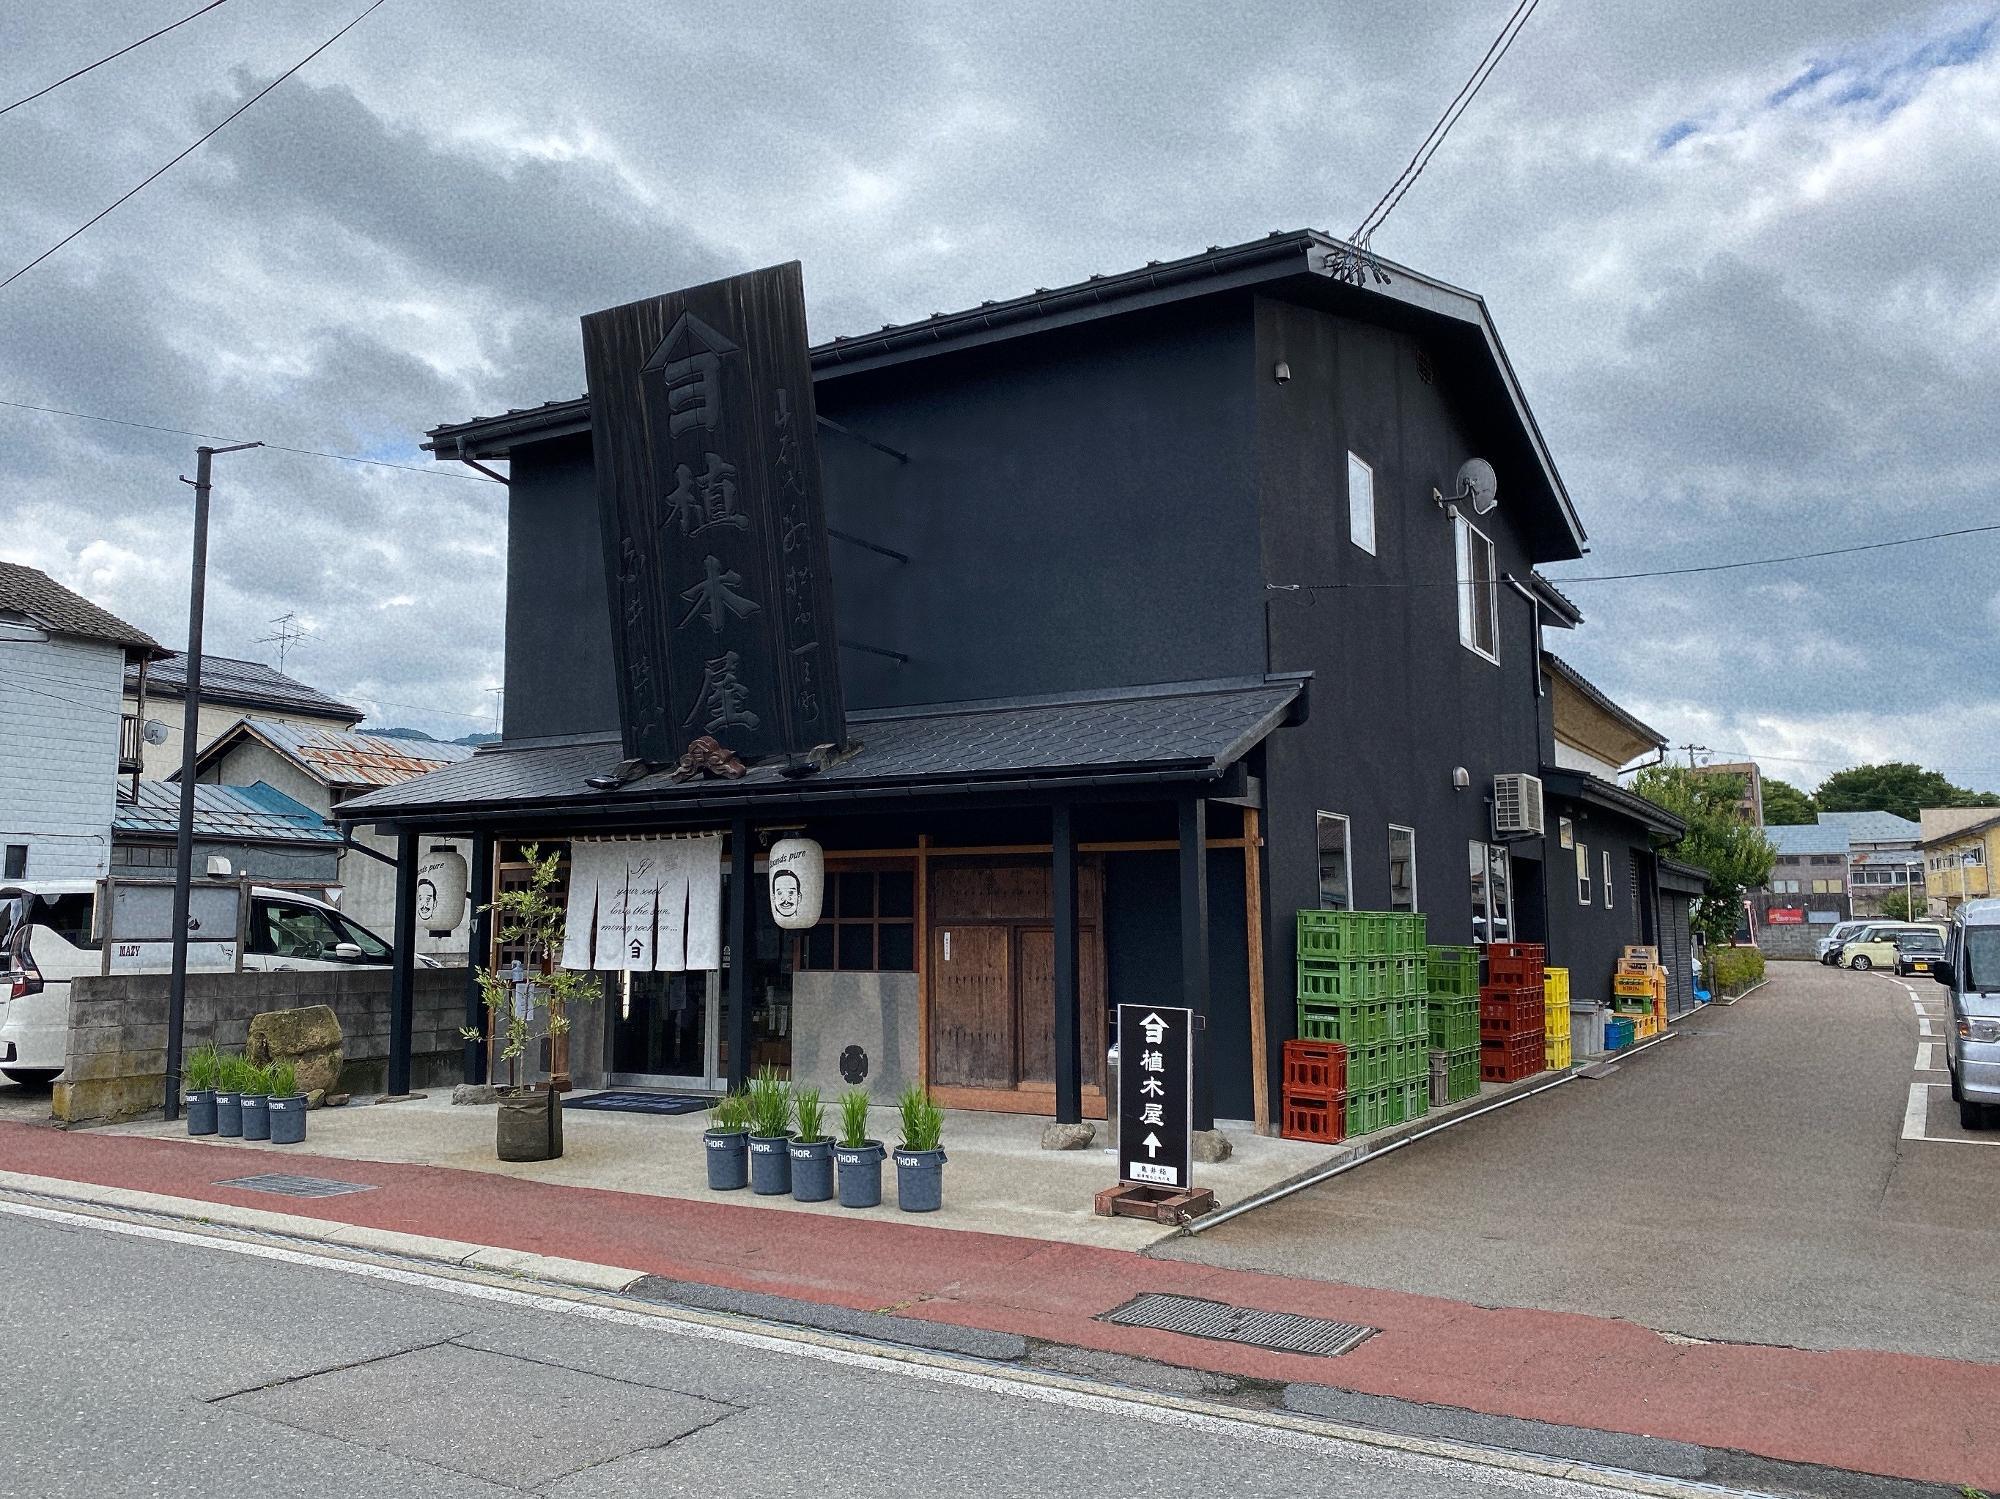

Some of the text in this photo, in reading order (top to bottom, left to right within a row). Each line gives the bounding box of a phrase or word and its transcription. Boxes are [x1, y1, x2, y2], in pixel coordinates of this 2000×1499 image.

[663, 451, 760, 735] 植木屋
[788, 849, 807, 862] pure
[633, 902, 649, 915] the
[119, 945, 141, 957] MAZY
[1139, 1049, 1165, 1127] 植木屋
[750, 1142, 773, 1153] THOR.
[790, 1148, 813, 1158] THOR.
[837, 1153, 861, 1164] THOR.
[896, 1156, 921, 1167] THOR.
